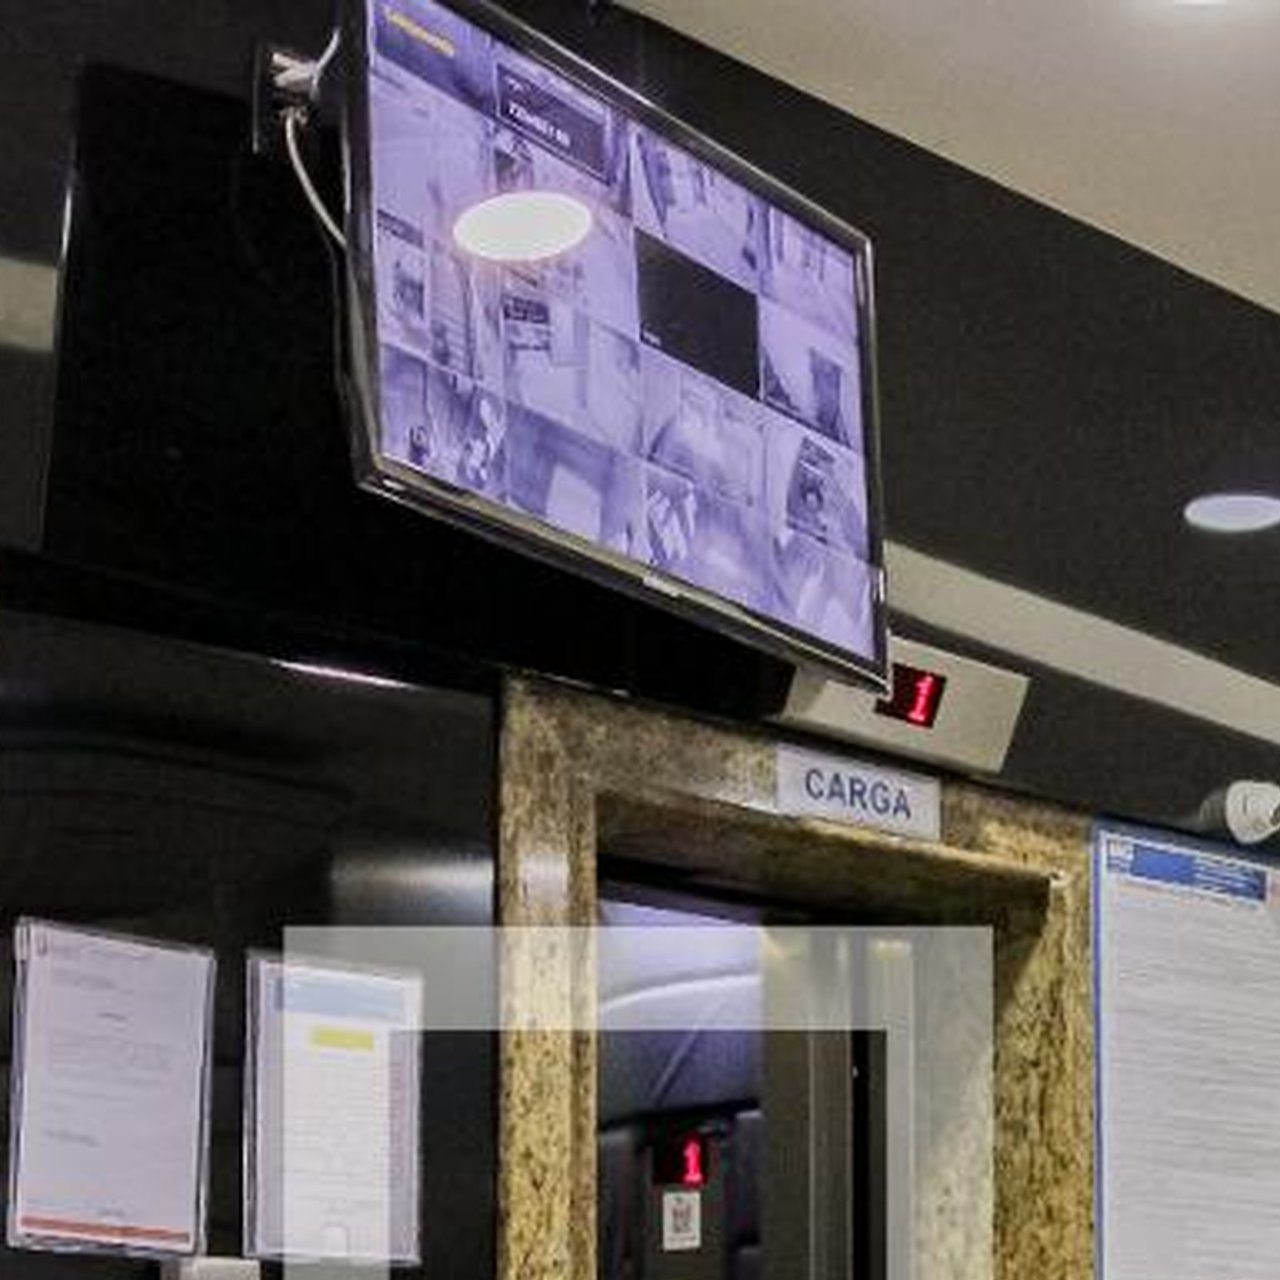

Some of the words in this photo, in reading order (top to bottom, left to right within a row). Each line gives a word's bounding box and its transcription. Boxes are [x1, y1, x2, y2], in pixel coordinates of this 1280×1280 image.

[907, 674, 934, 722] 1
[805, 768, 912, 819] CARGA
[683, 1141, 703, 1182] 1
